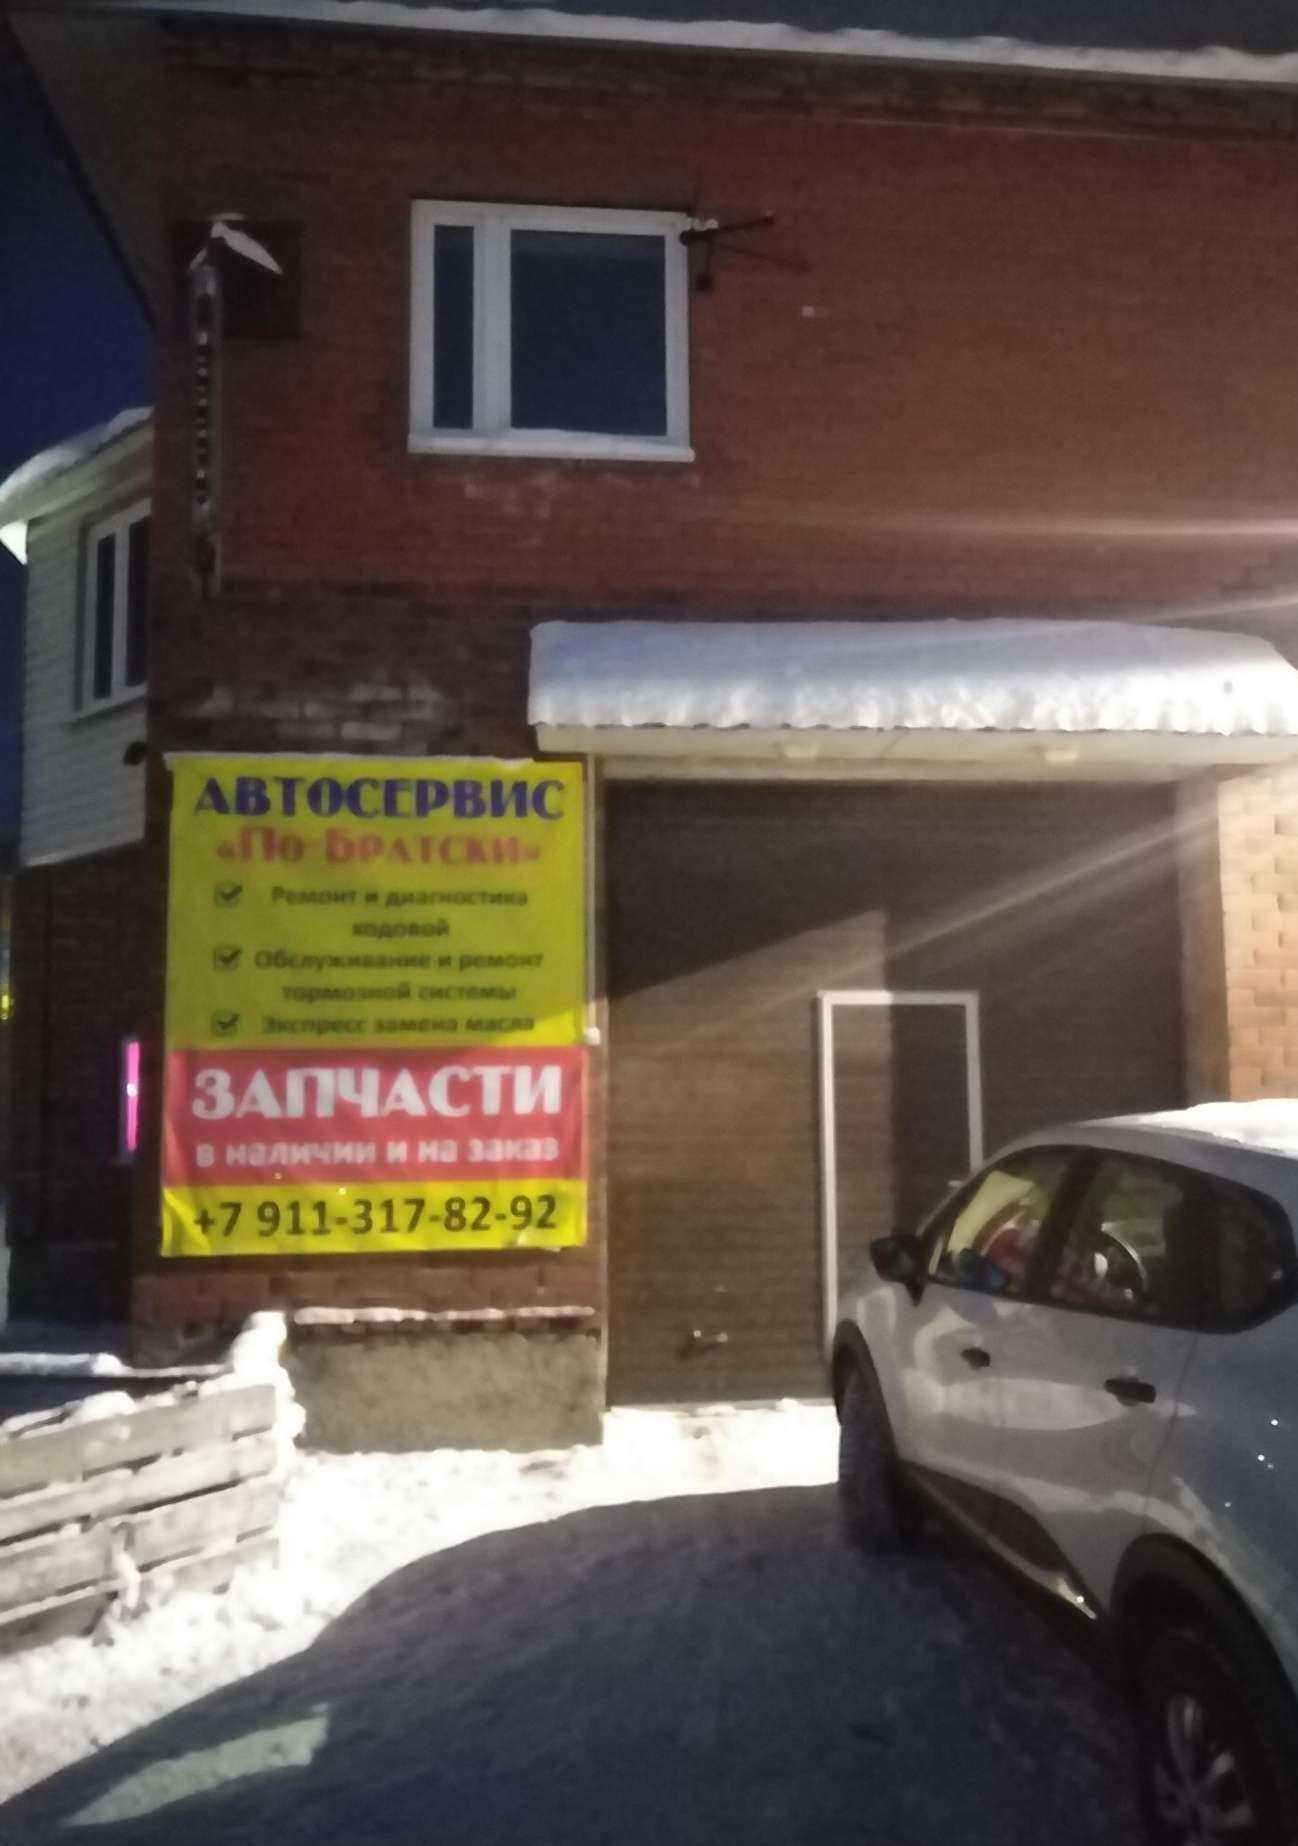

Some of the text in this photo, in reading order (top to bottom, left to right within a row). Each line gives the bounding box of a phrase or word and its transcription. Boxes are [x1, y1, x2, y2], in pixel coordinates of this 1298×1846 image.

[195, 777, 566, 820] АВТОСЕРВИС
[365, 889, 379, 905] и
[439, 955, 452, 969] и
[192, 1065, 562, 1120] ЗАПЧАСТИ
[196, 1147, 215, 1167] в
[387, 1142, 406, 1163] и
[418, 1141, 457, 1163] на
[467, 1137, 559, 1163] заказ
[196, 1194, 558, 1237] +7 911-317-82-92
